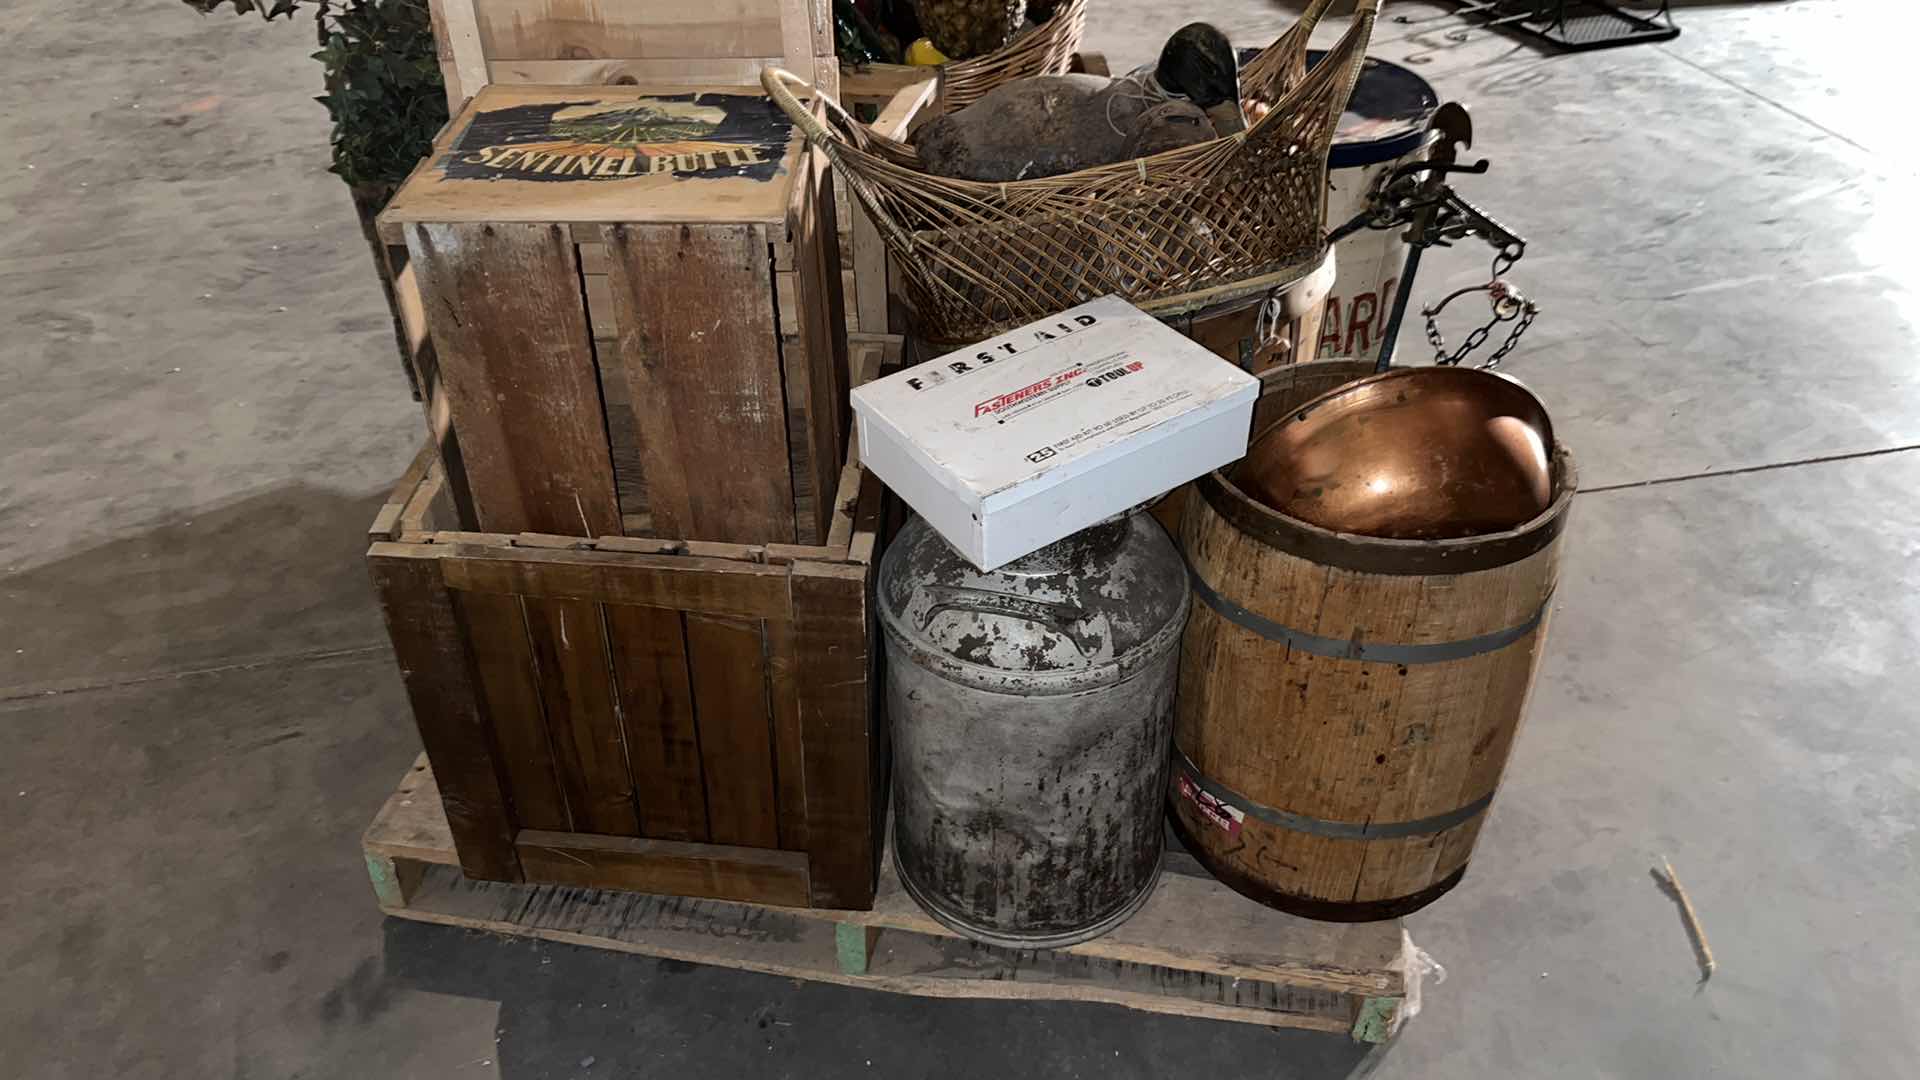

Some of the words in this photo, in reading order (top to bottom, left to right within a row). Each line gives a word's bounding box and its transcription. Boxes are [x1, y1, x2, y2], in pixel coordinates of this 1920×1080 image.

[462, 145, 638, 175] SENTINEL
[650, 144, 770, 173] BUTTE
[1034, 315, 1097, 340] AID
[975, 377, 1051, 417] FASTENERS
[1029, 447, 1055, 462] 25
